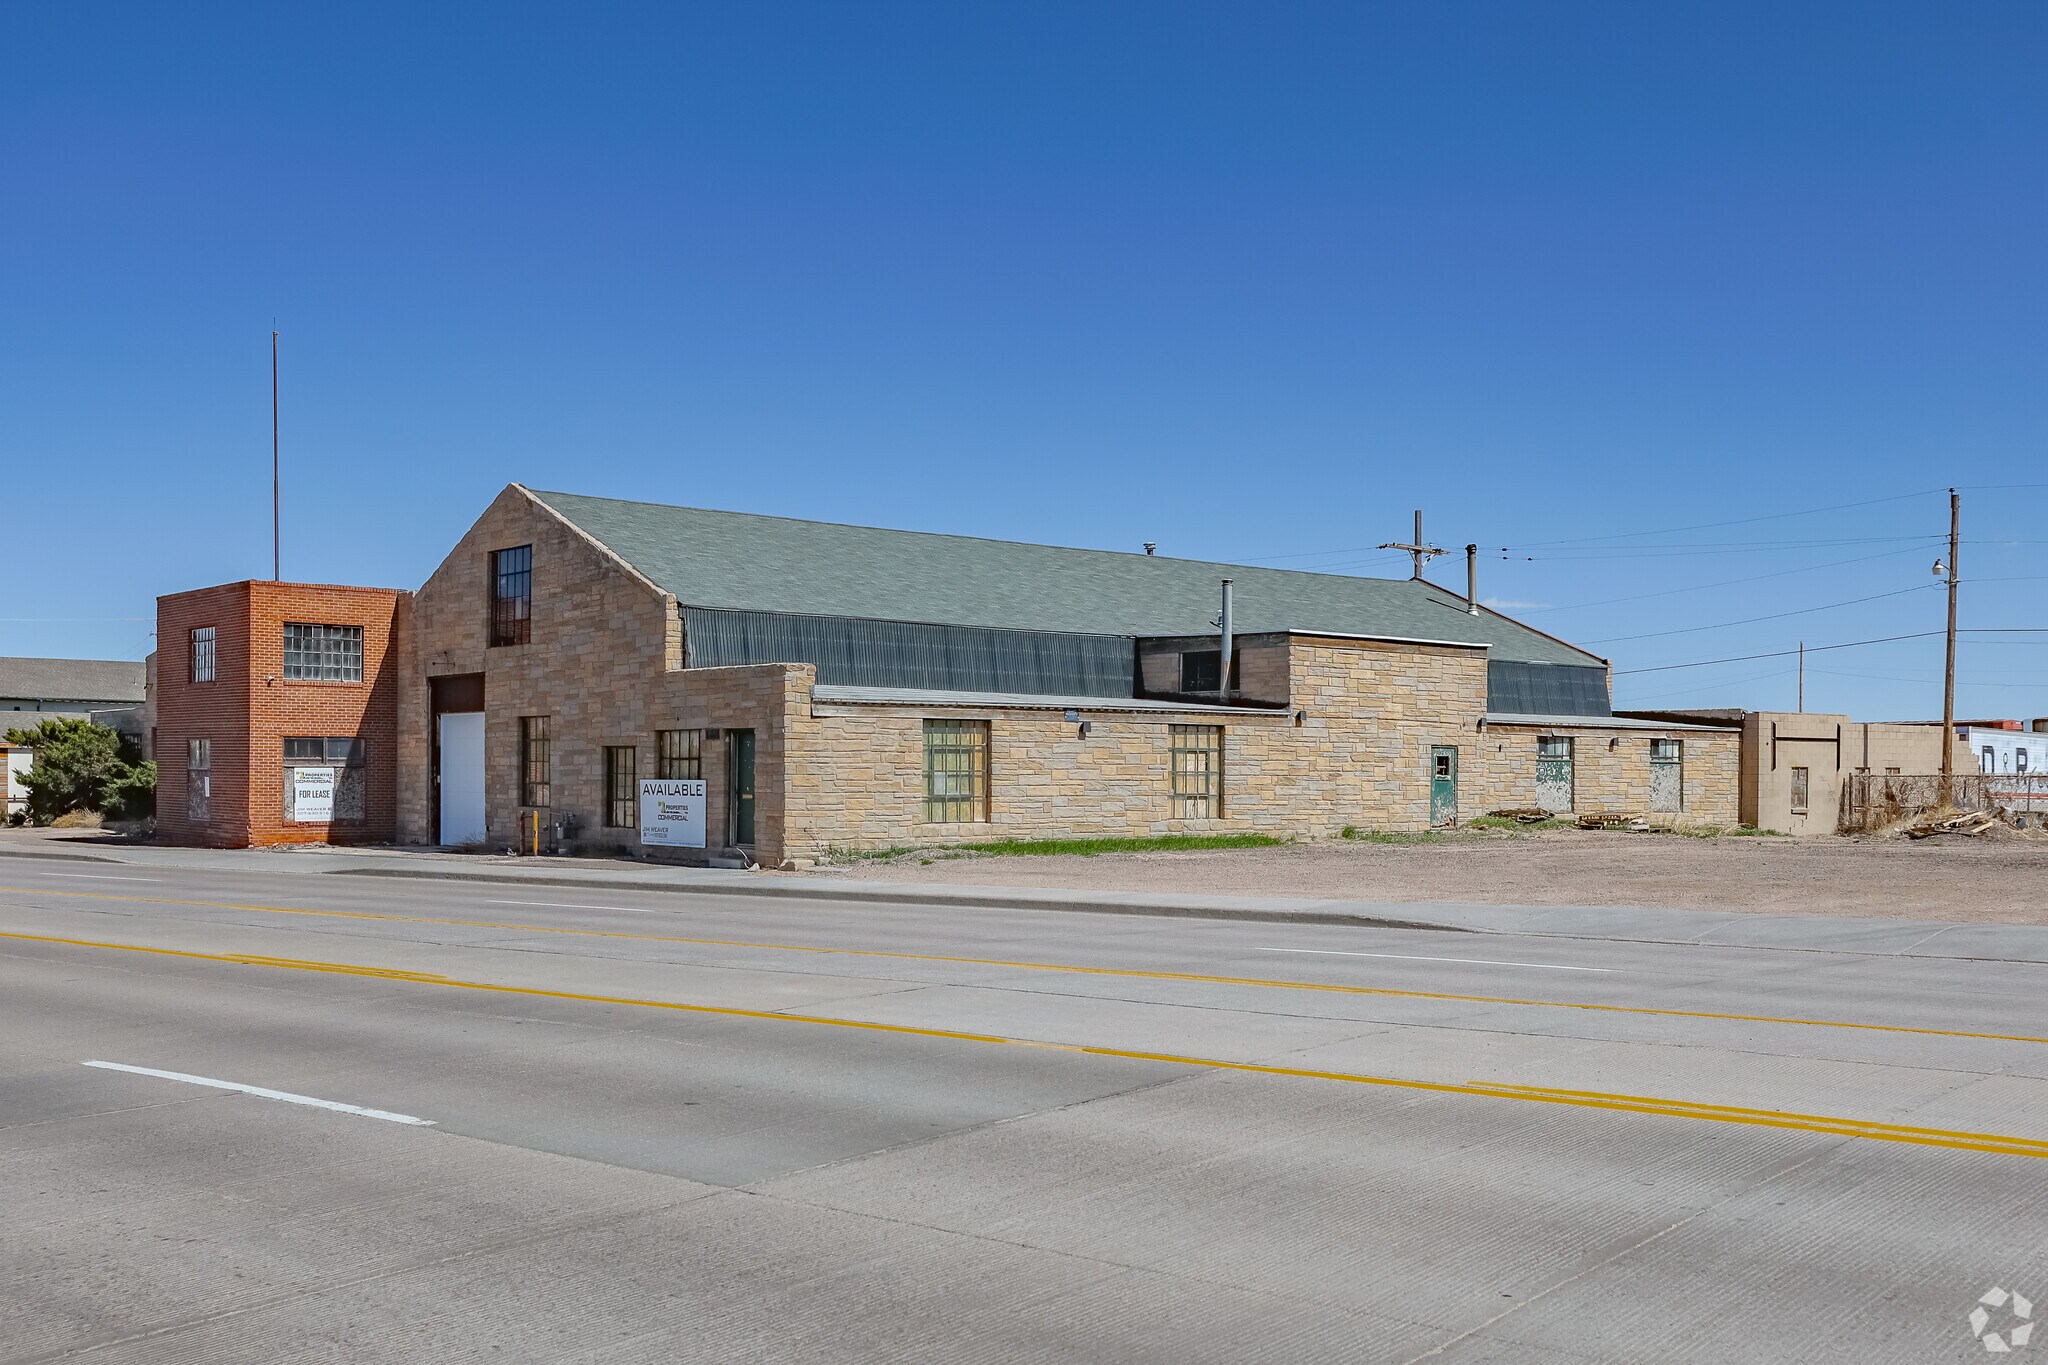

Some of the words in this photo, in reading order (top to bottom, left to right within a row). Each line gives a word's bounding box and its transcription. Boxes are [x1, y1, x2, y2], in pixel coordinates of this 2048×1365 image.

[299, 790, 311, 799] FOR
[312, 790, 331, 799] LEASE
[642, 783, 703, 797] AVAILABLE
[657, 814, 689, 822] COMMERCIAL
